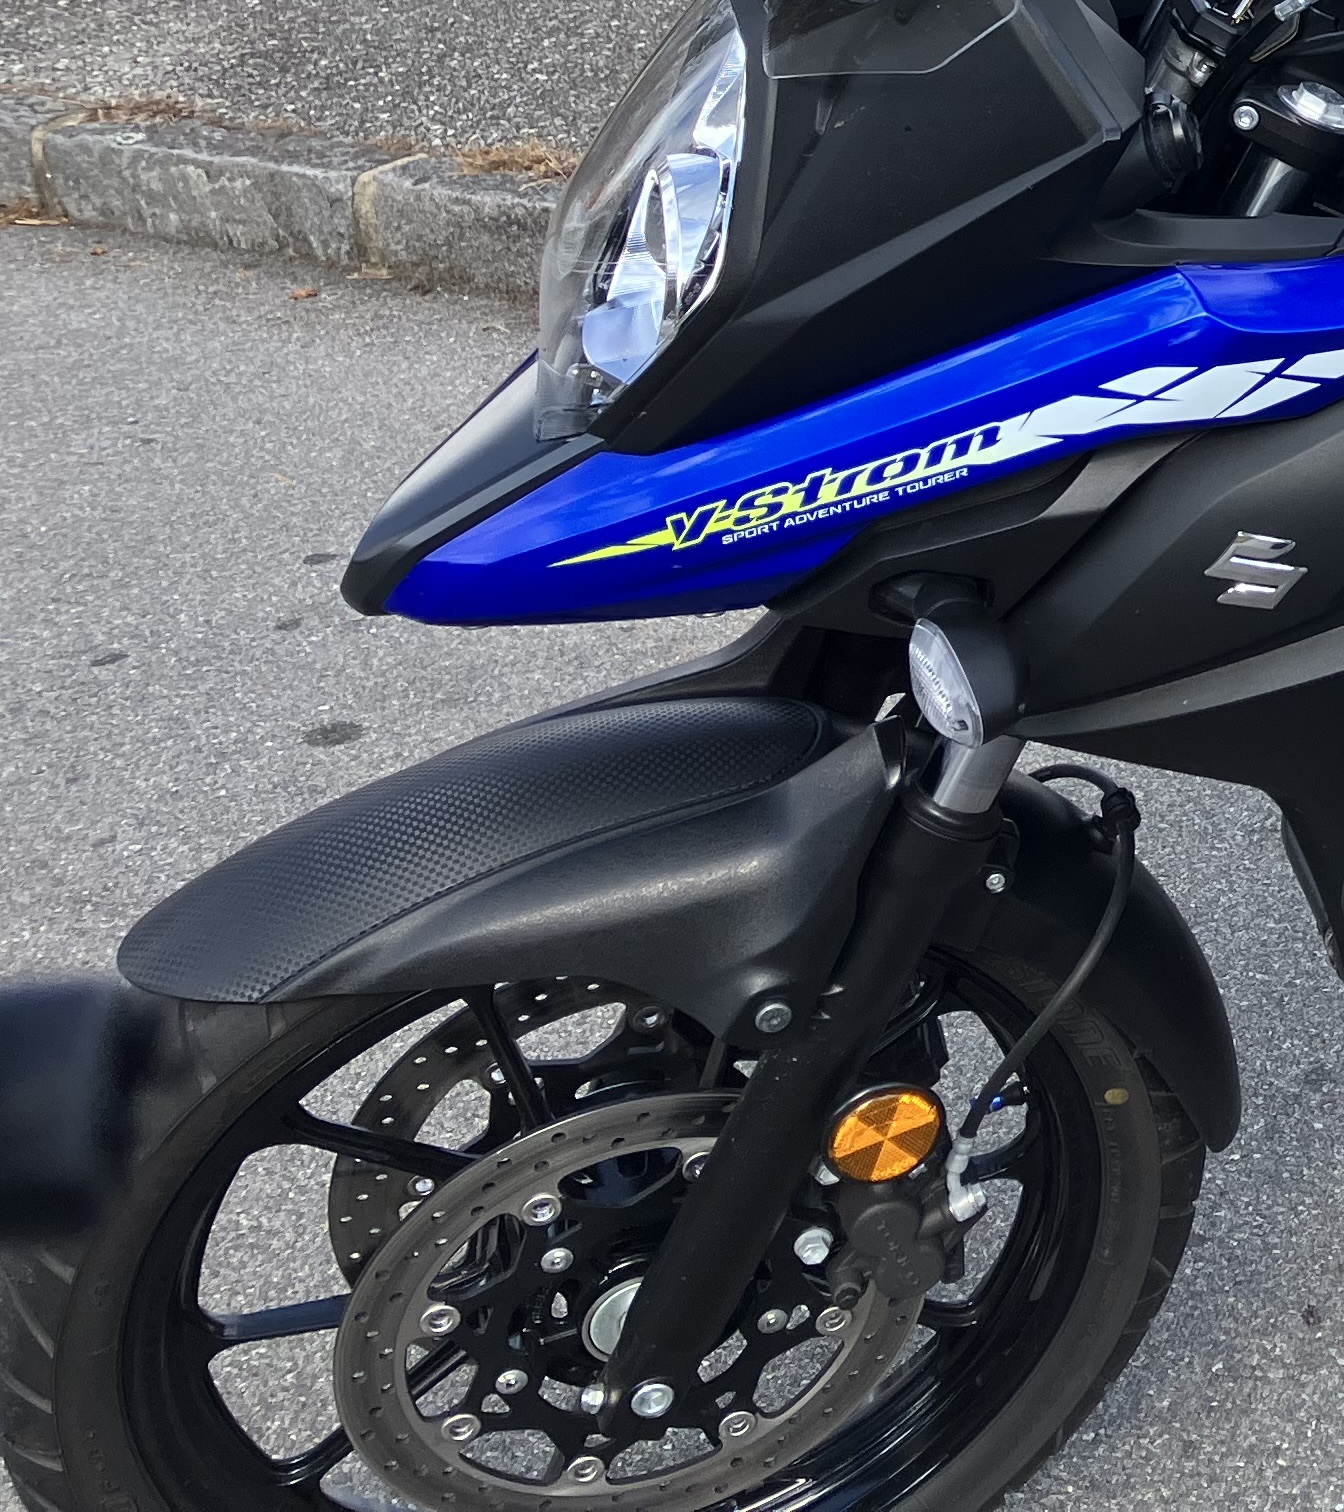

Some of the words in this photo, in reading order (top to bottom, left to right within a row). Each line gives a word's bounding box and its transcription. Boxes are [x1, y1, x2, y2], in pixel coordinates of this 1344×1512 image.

[721, 520, 781, 546] SPORT
[784, 491, 891, 529] ADVENTURE
[894, 467, 969, 498] TOURER
